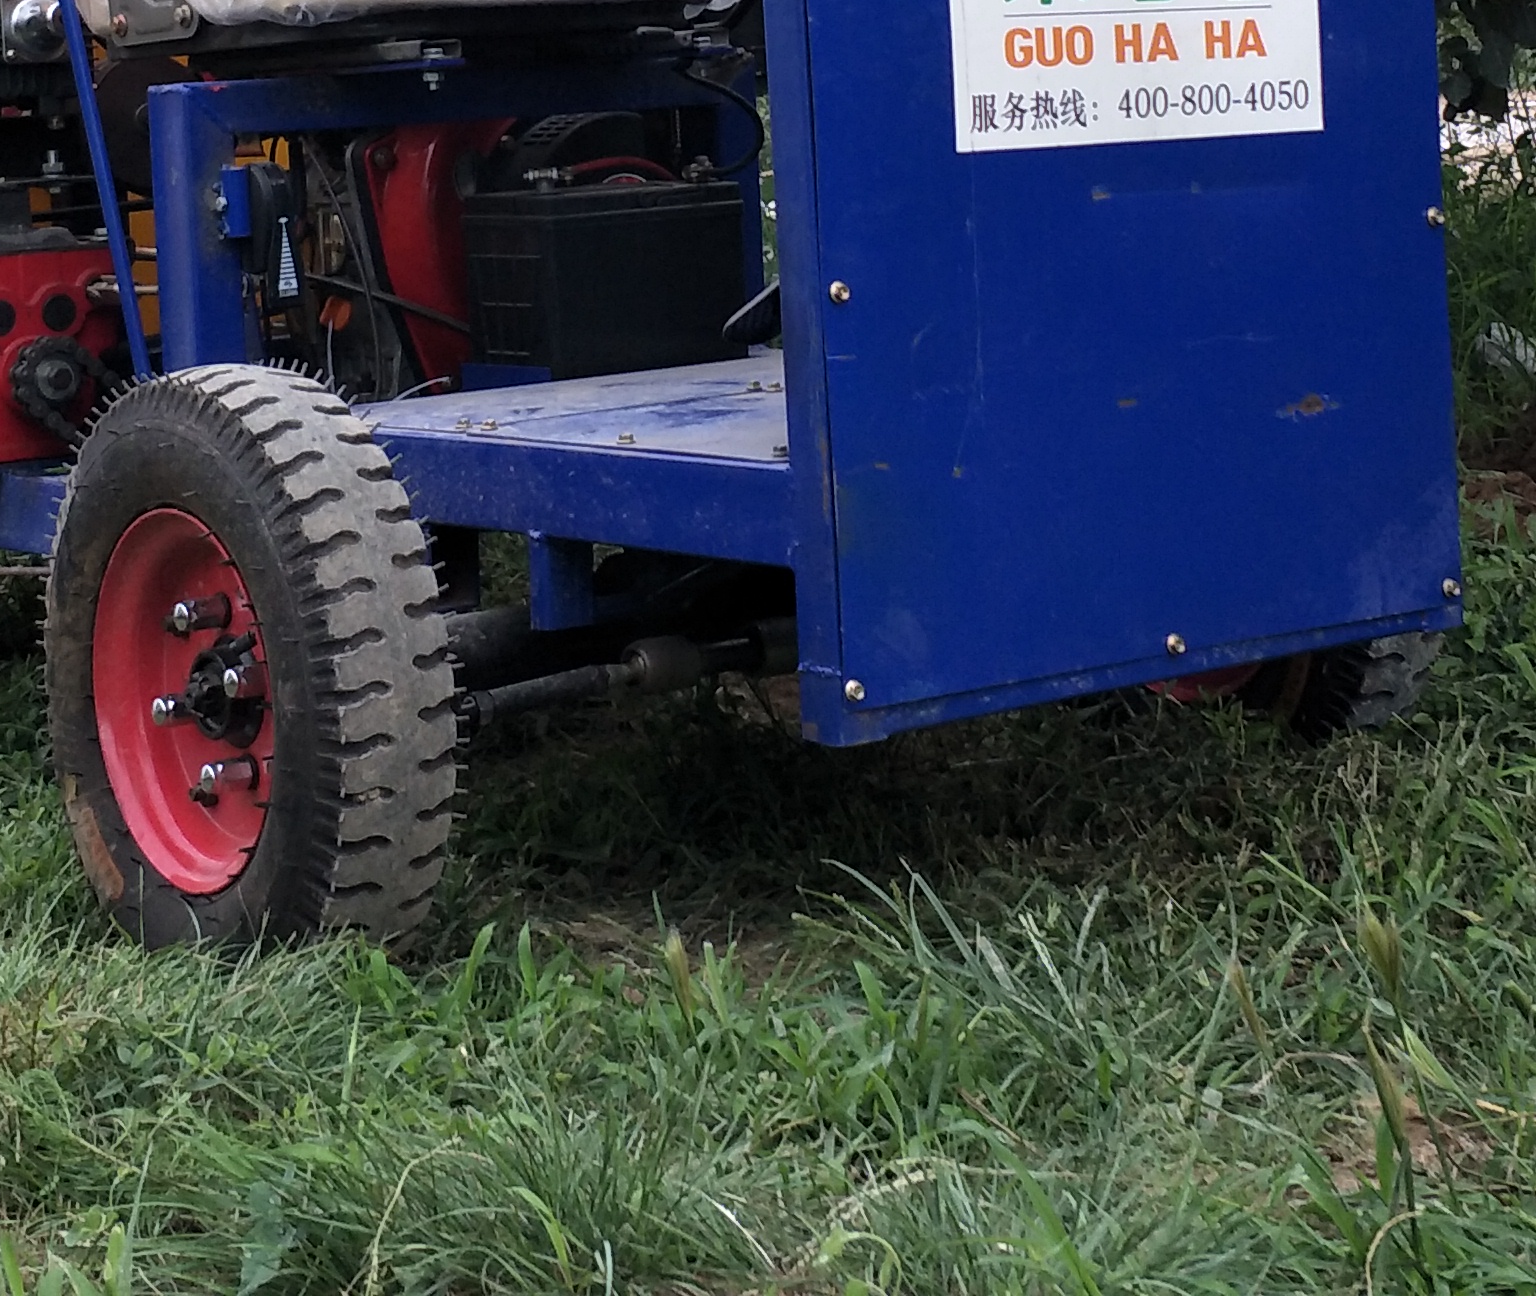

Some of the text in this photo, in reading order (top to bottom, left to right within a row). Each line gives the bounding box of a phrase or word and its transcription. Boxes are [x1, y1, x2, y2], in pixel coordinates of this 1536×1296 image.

[1004, 19, 1267, 68] GUO HA HA
